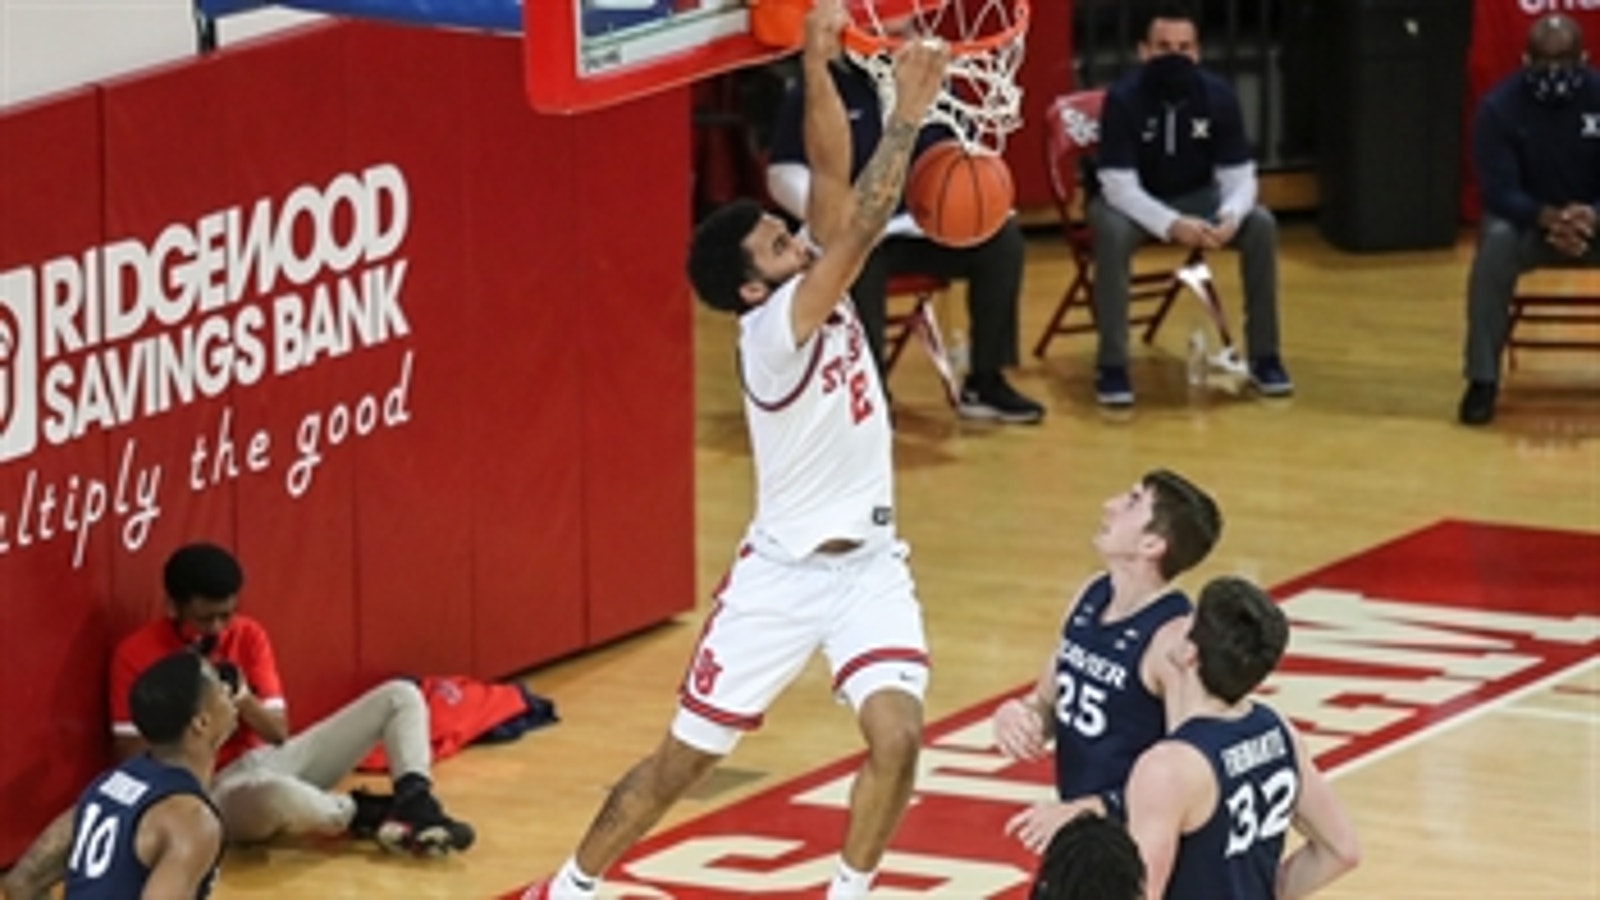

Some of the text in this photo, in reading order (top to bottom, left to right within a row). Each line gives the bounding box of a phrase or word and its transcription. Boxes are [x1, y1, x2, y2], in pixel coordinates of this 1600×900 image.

[41, 163, 410, 358] RIDGEWOOD
[43, 260, 411, 445] SAVINGS BANK
[190, 407, 270, 491] the
[286, 350, 413, 498] good
[1056, 673, 1107, 737] 25
[68, 802, 119, 879] 10
[1223, 767, 1298, 858] 32
